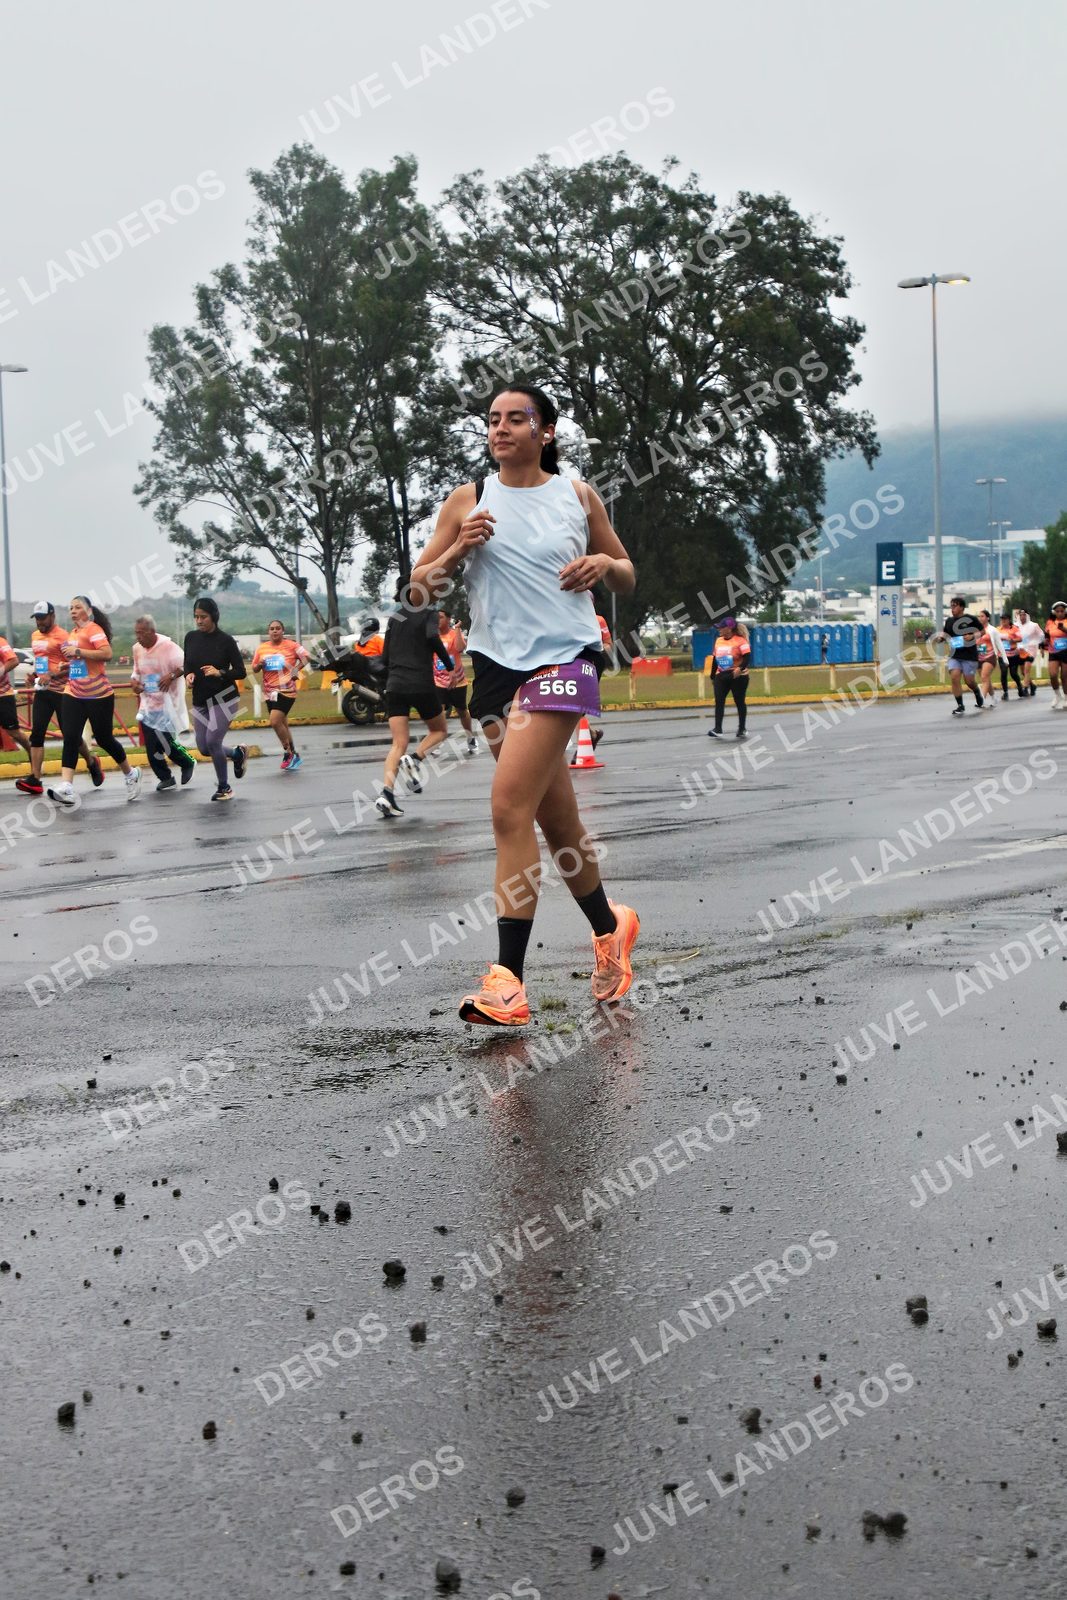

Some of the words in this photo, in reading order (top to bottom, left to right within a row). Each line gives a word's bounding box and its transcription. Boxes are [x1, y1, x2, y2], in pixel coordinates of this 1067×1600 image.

[882, 560, 896, 580] E
[891, 594, 899, 626] General
[539, 679, 578, 696] 566
